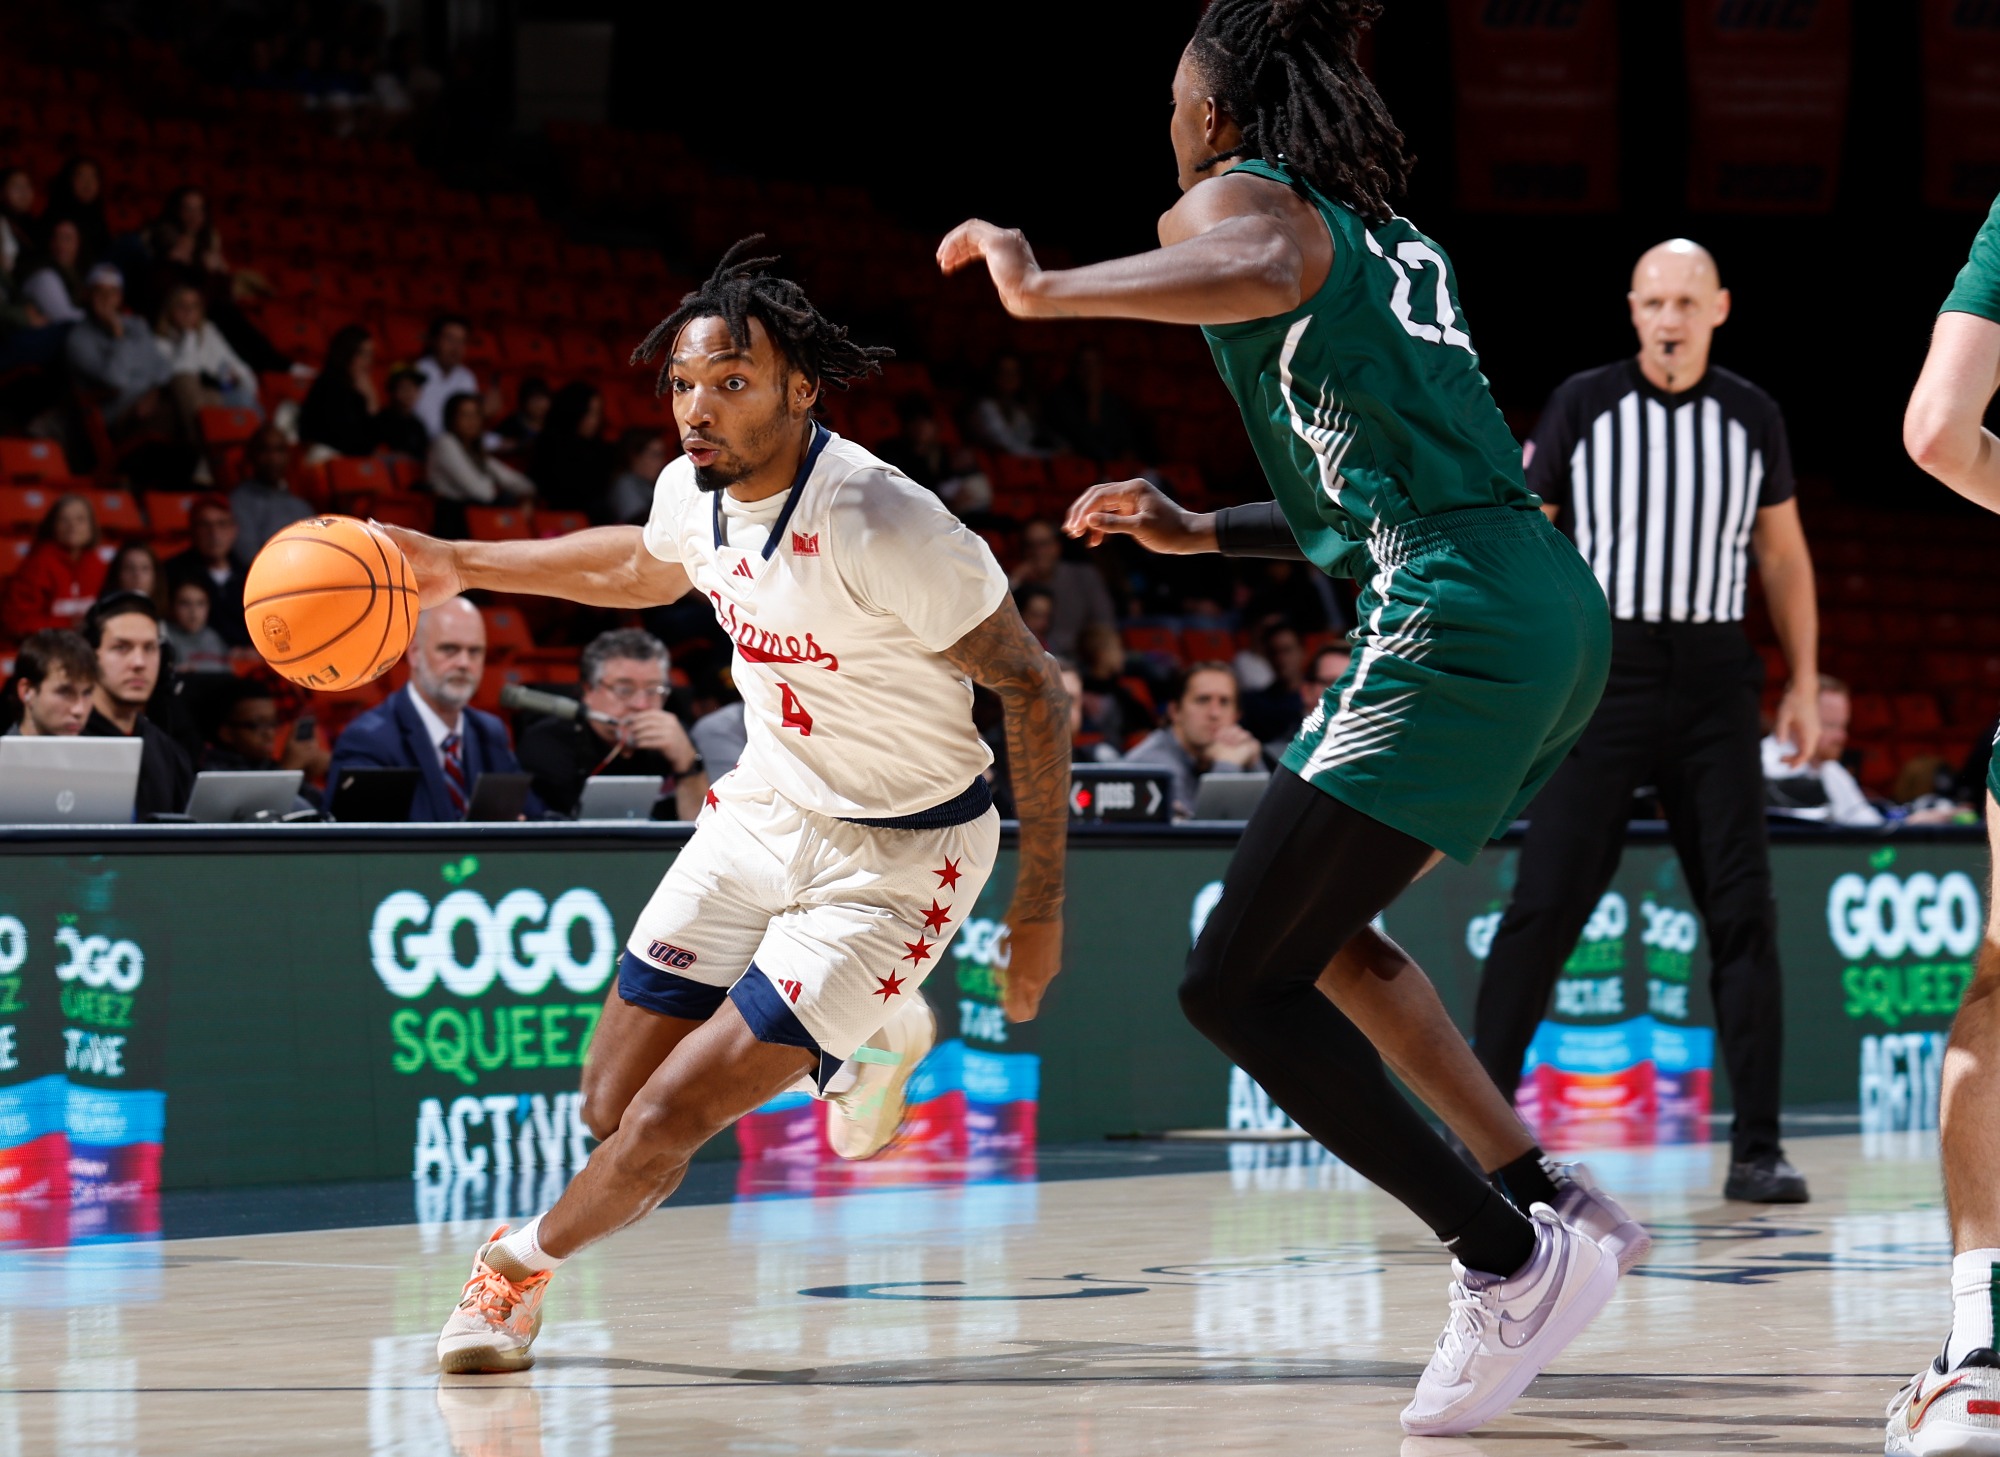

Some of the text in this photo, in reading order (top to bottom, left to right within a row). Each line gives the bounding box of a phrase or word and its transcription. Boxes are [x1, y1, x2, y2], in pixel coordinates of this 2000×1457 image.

[775, 683, 814, 736] 4
[369, 888, 617, 999] GOGO
[647, 939, 697, 970] UIC
[1827, 871, 1982, 960] GOGO
[390, 1003, 601, 1086] SQUEEZ
